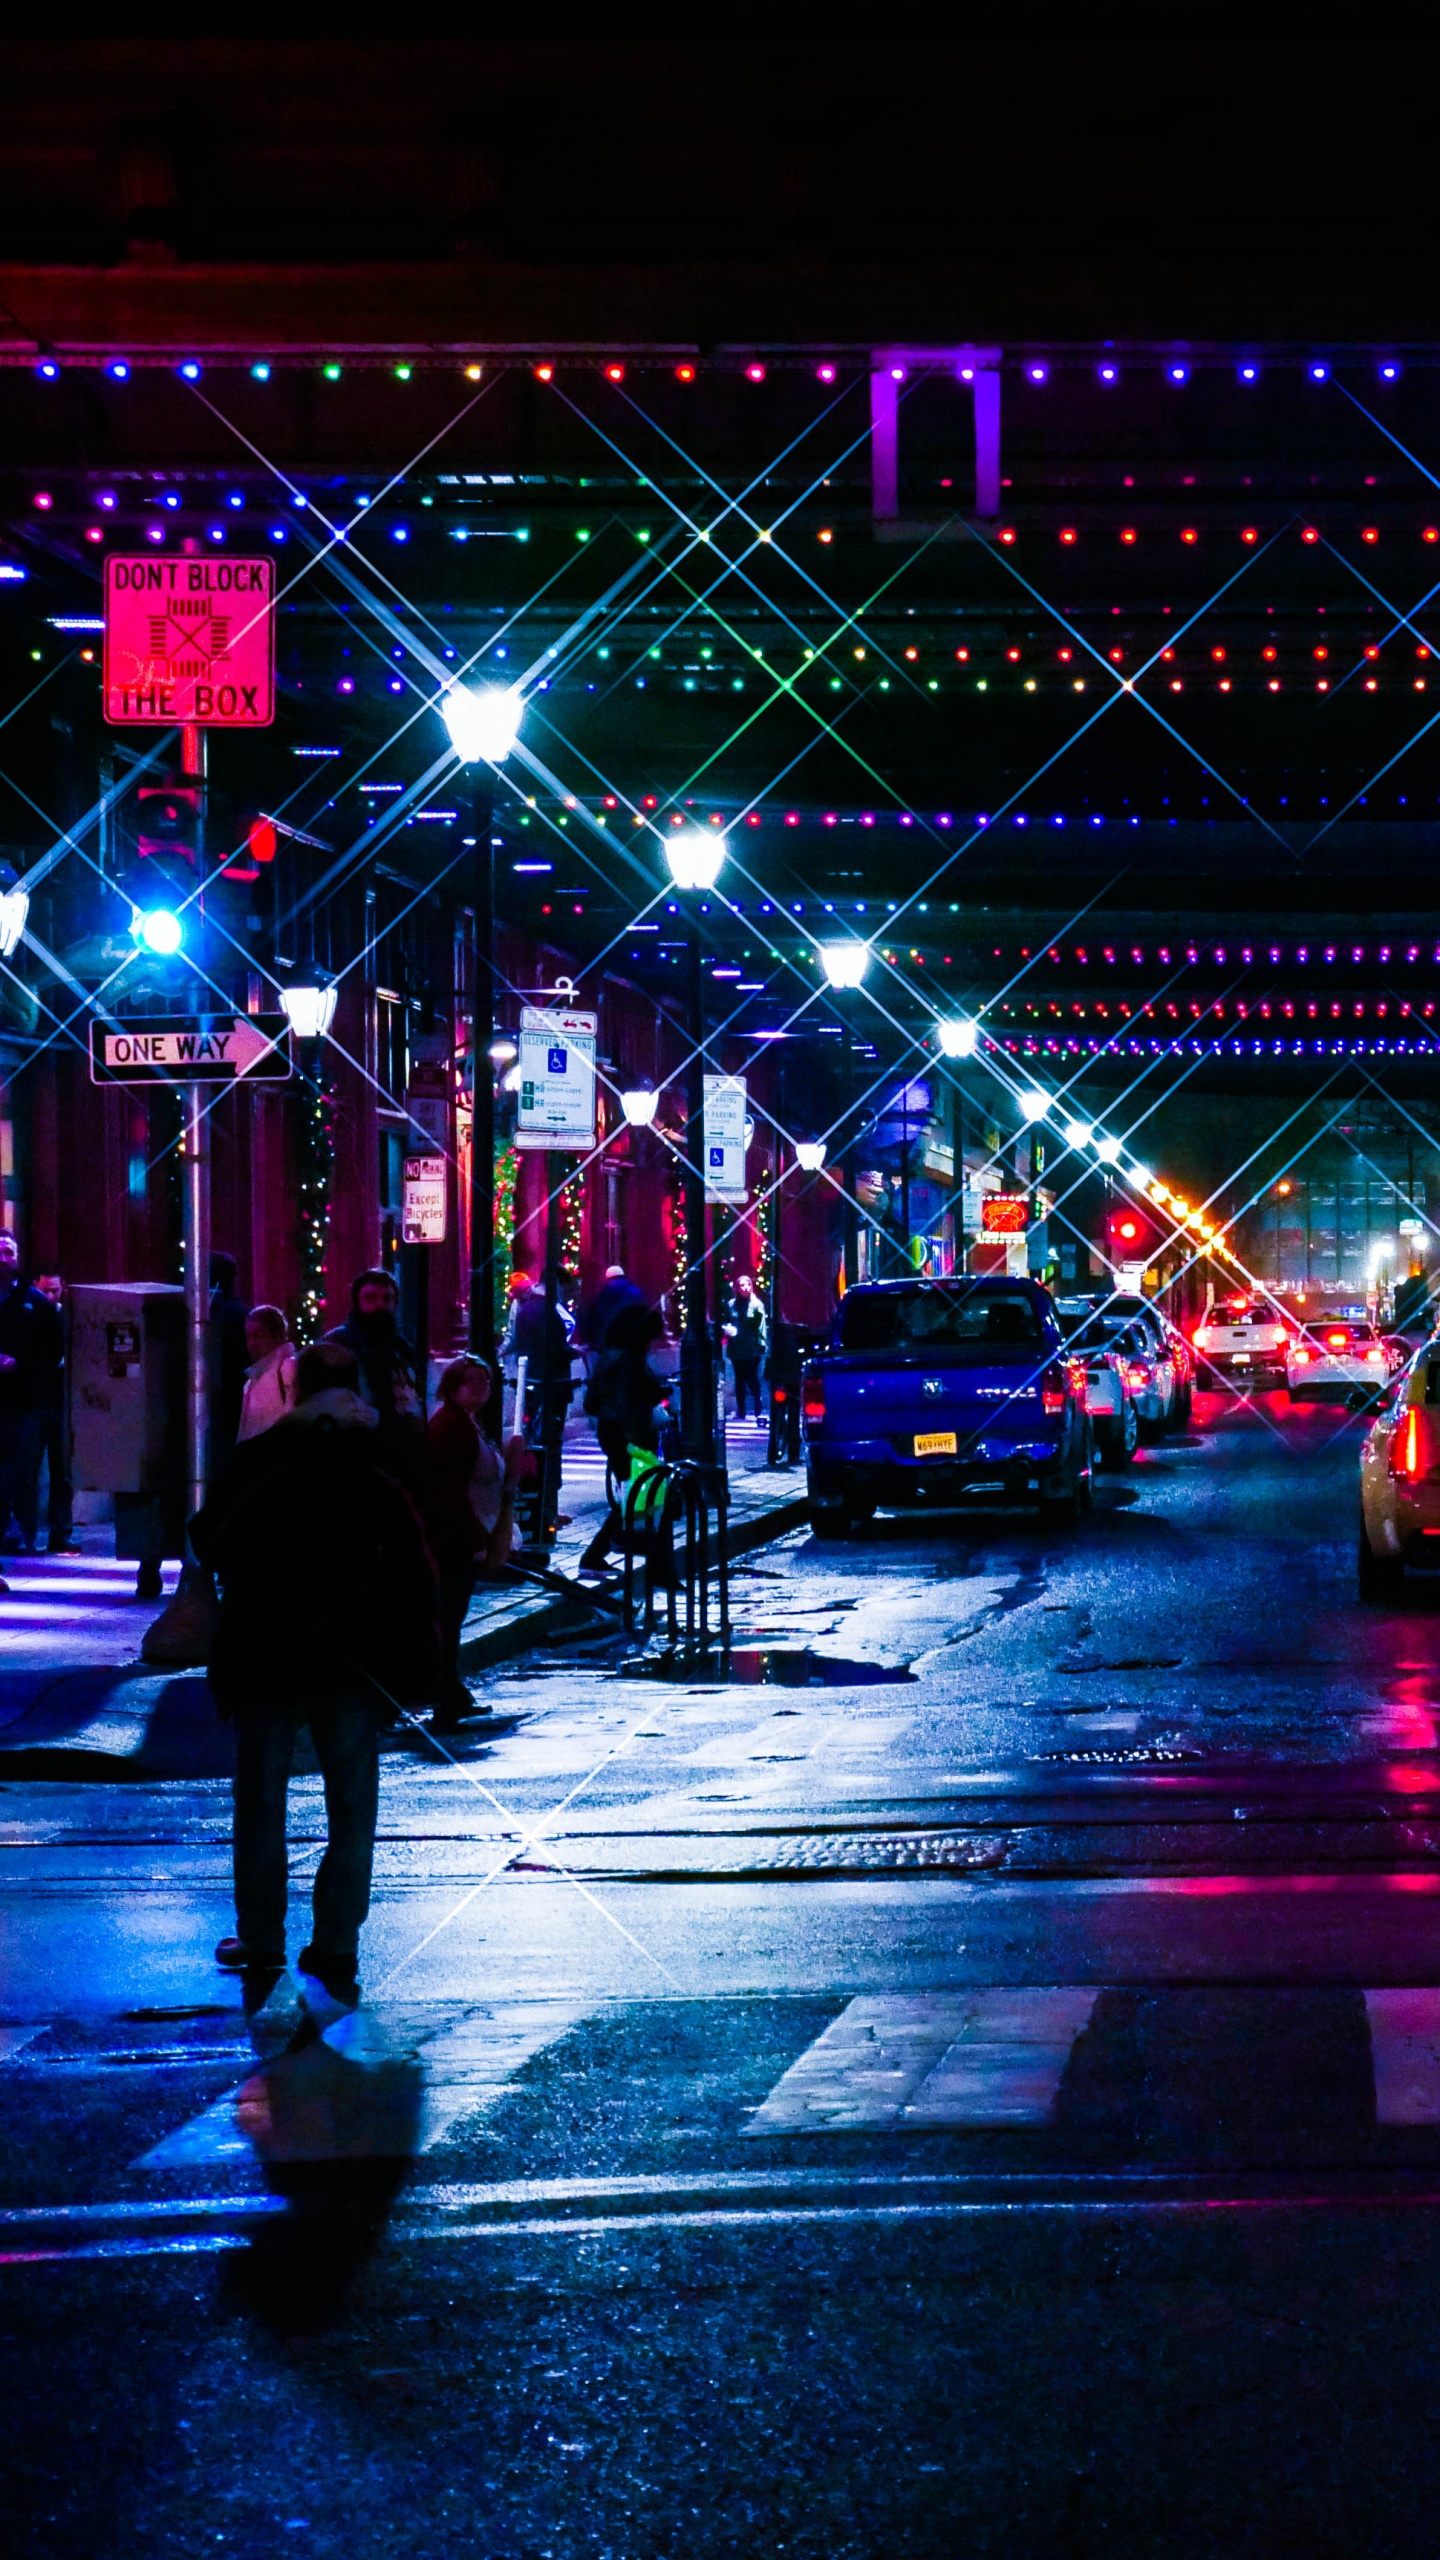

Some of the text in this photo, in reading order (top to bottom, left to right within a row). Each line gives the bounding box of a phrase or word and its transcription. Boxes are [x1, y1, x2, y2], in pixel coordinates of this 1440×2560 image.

[188, 564, 264, 591] BLOCK
[118, 684, 258, 716] THE BOX
[114, 1035, 230, 1062] ONE WAY
[406, 1161, 420, 1178] NO
[409, 1193, 440, 1206] Except
[406, 1207, 443, 1222] Bicycles
